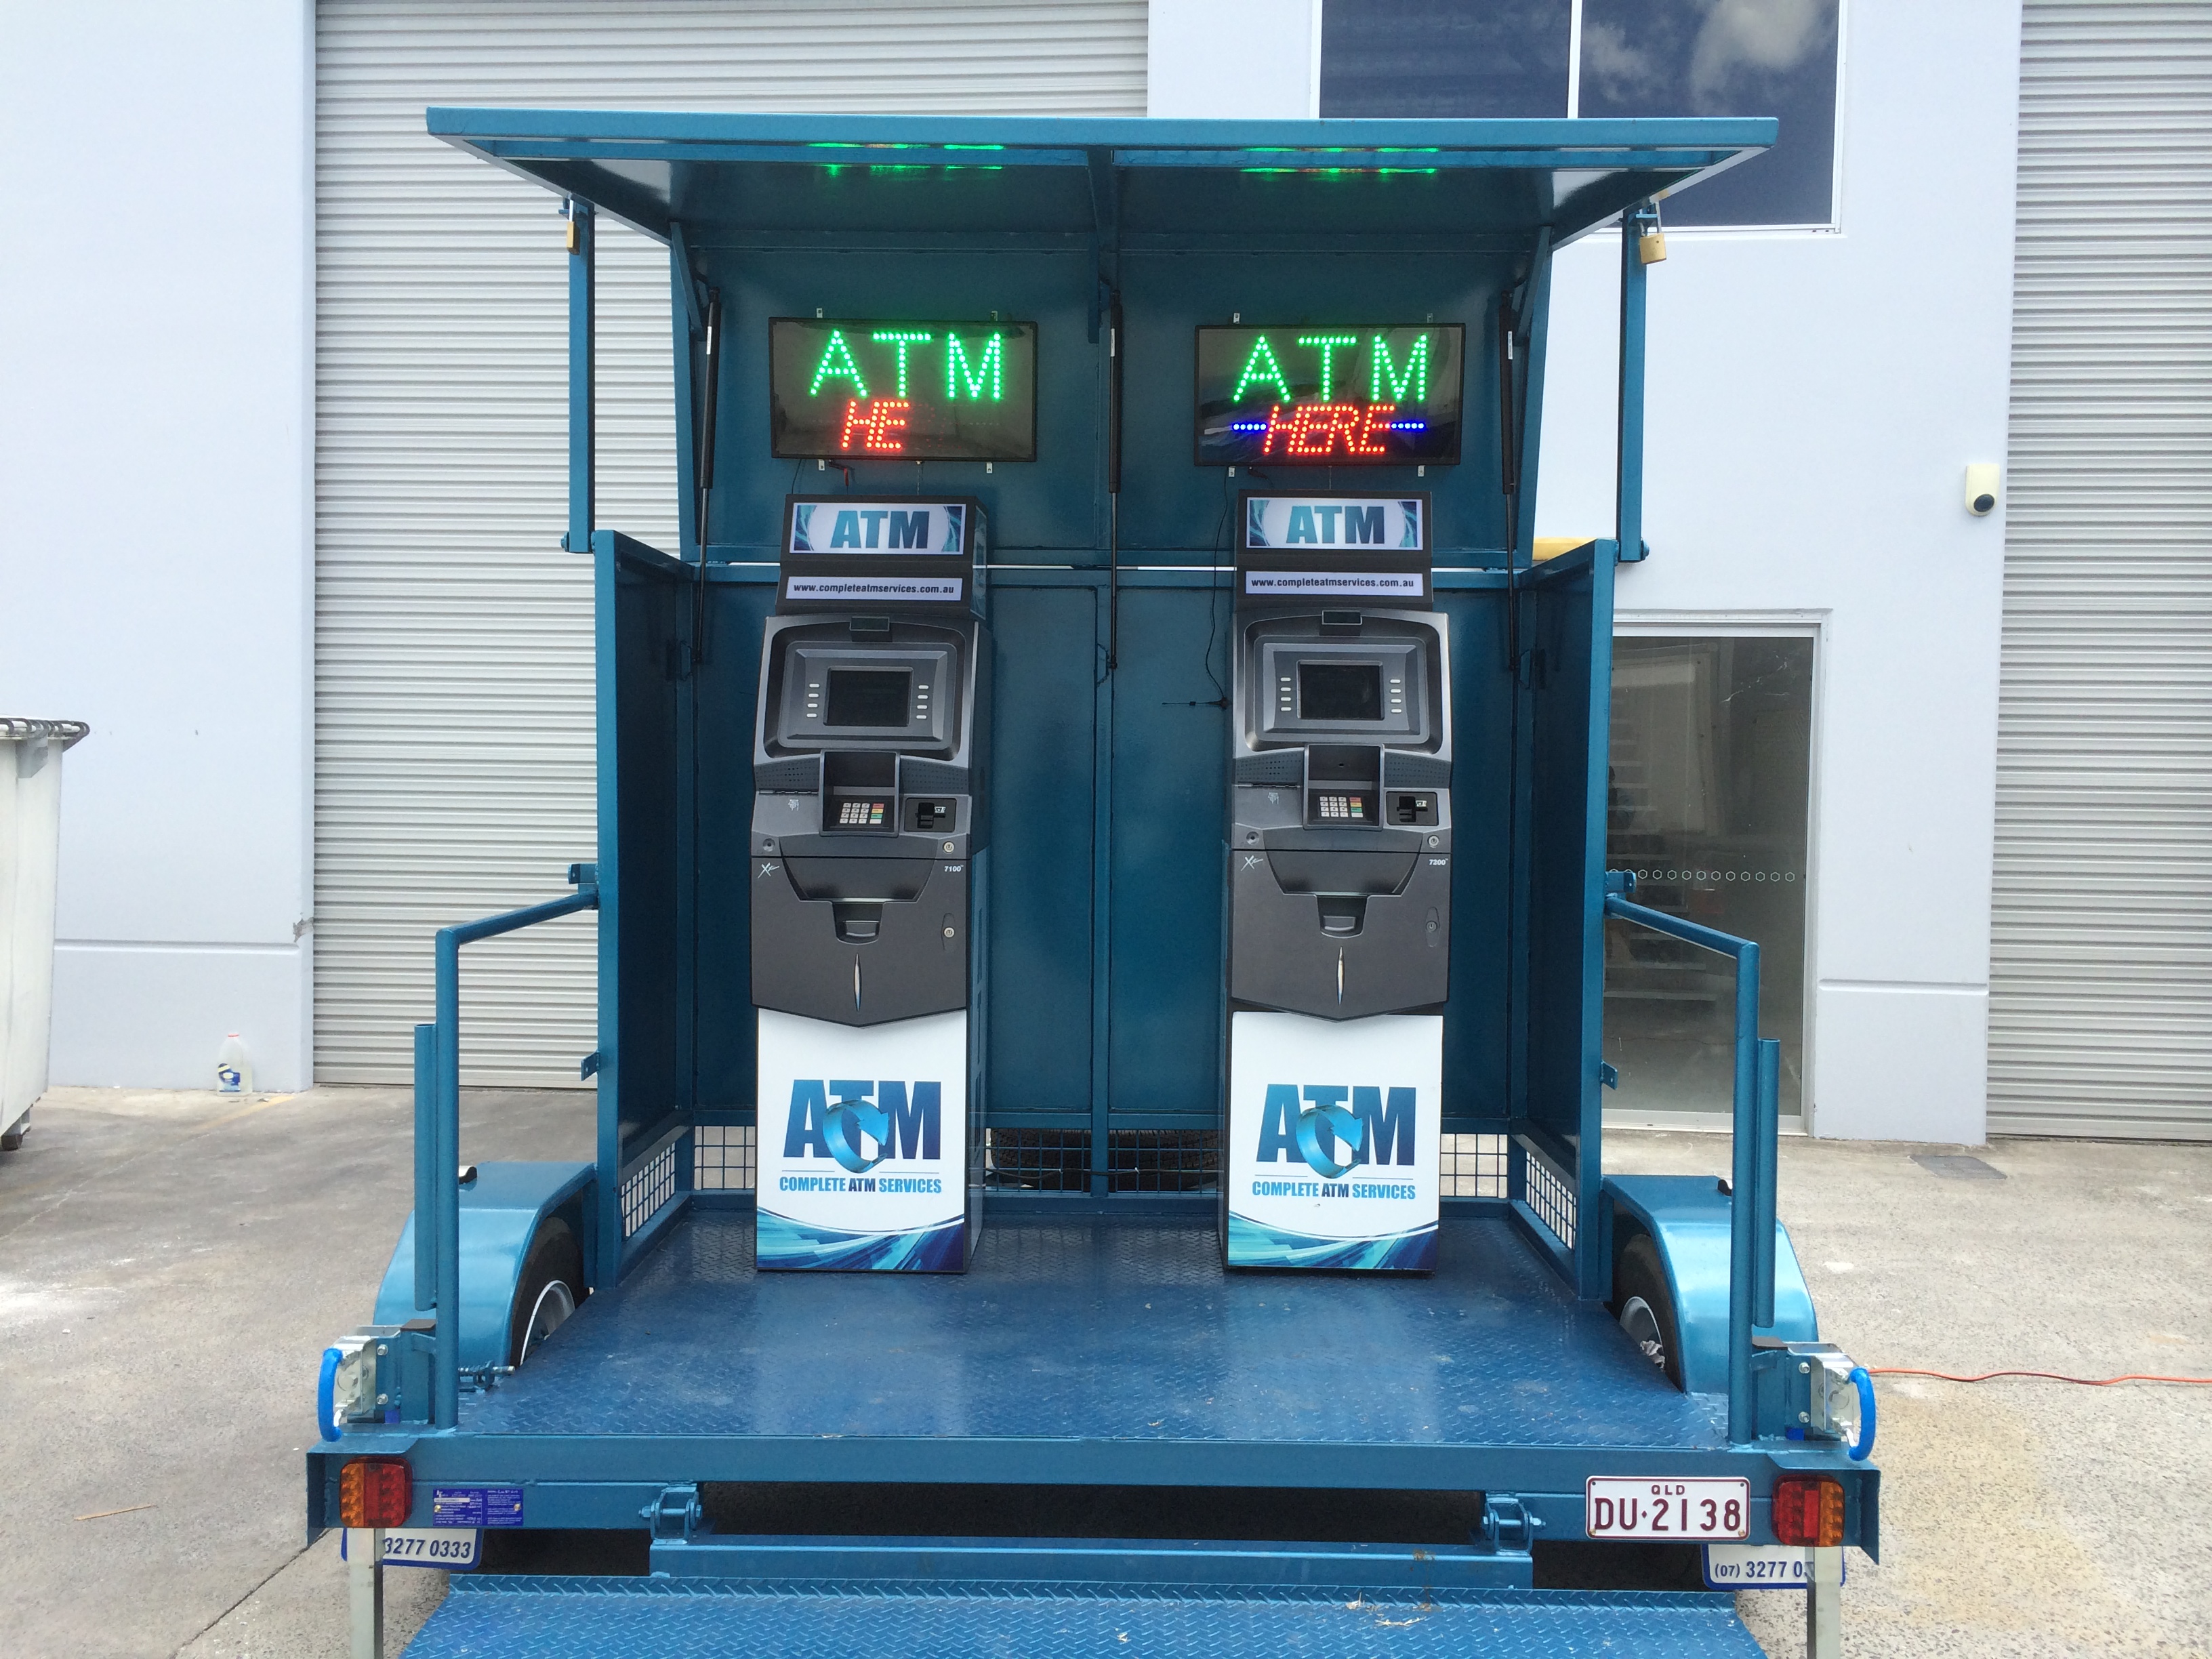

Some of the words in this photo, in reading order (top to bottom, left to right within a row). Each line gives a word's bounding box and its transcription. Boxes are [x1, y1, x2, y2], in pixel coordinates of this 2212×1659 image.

[810, 329, 1002, 398] ATM
[1233, 334, 1427, 402] ATM
[841, 400, 909, 449] HE
[1263, 405, 1395, 454] HERE
[830, 510, 930, 550] ATM
[1286, 506, 1385, 545] ATM
[793, 582, 955, 594] www.completeatmservices.com.au
[1251, 577, 1414, 589] www.completeatmservices.com.au
[783, 1080, 942, 1160] ATM
[1256, 1084, 1416, 1166] ATM
[779, 1176, 846, 1192] COMPLETE
[848, 1178, 876, 1193] ATM
[878, 1178, 942, 1193] SERVICES
[1252, 1181, 1319, 1197] COMPLETE
[1321, 1183, 1349, 1198] ATM
[1351, 1184, 1416, 1200] SERVICES
[1651, 1484, 1685, 1496] QLD
[429, 1540, 472, 1559] 0333
[1715, 1563, 1740, 1578] (07)
[1746, 1561, 1788, 1578] 3277
